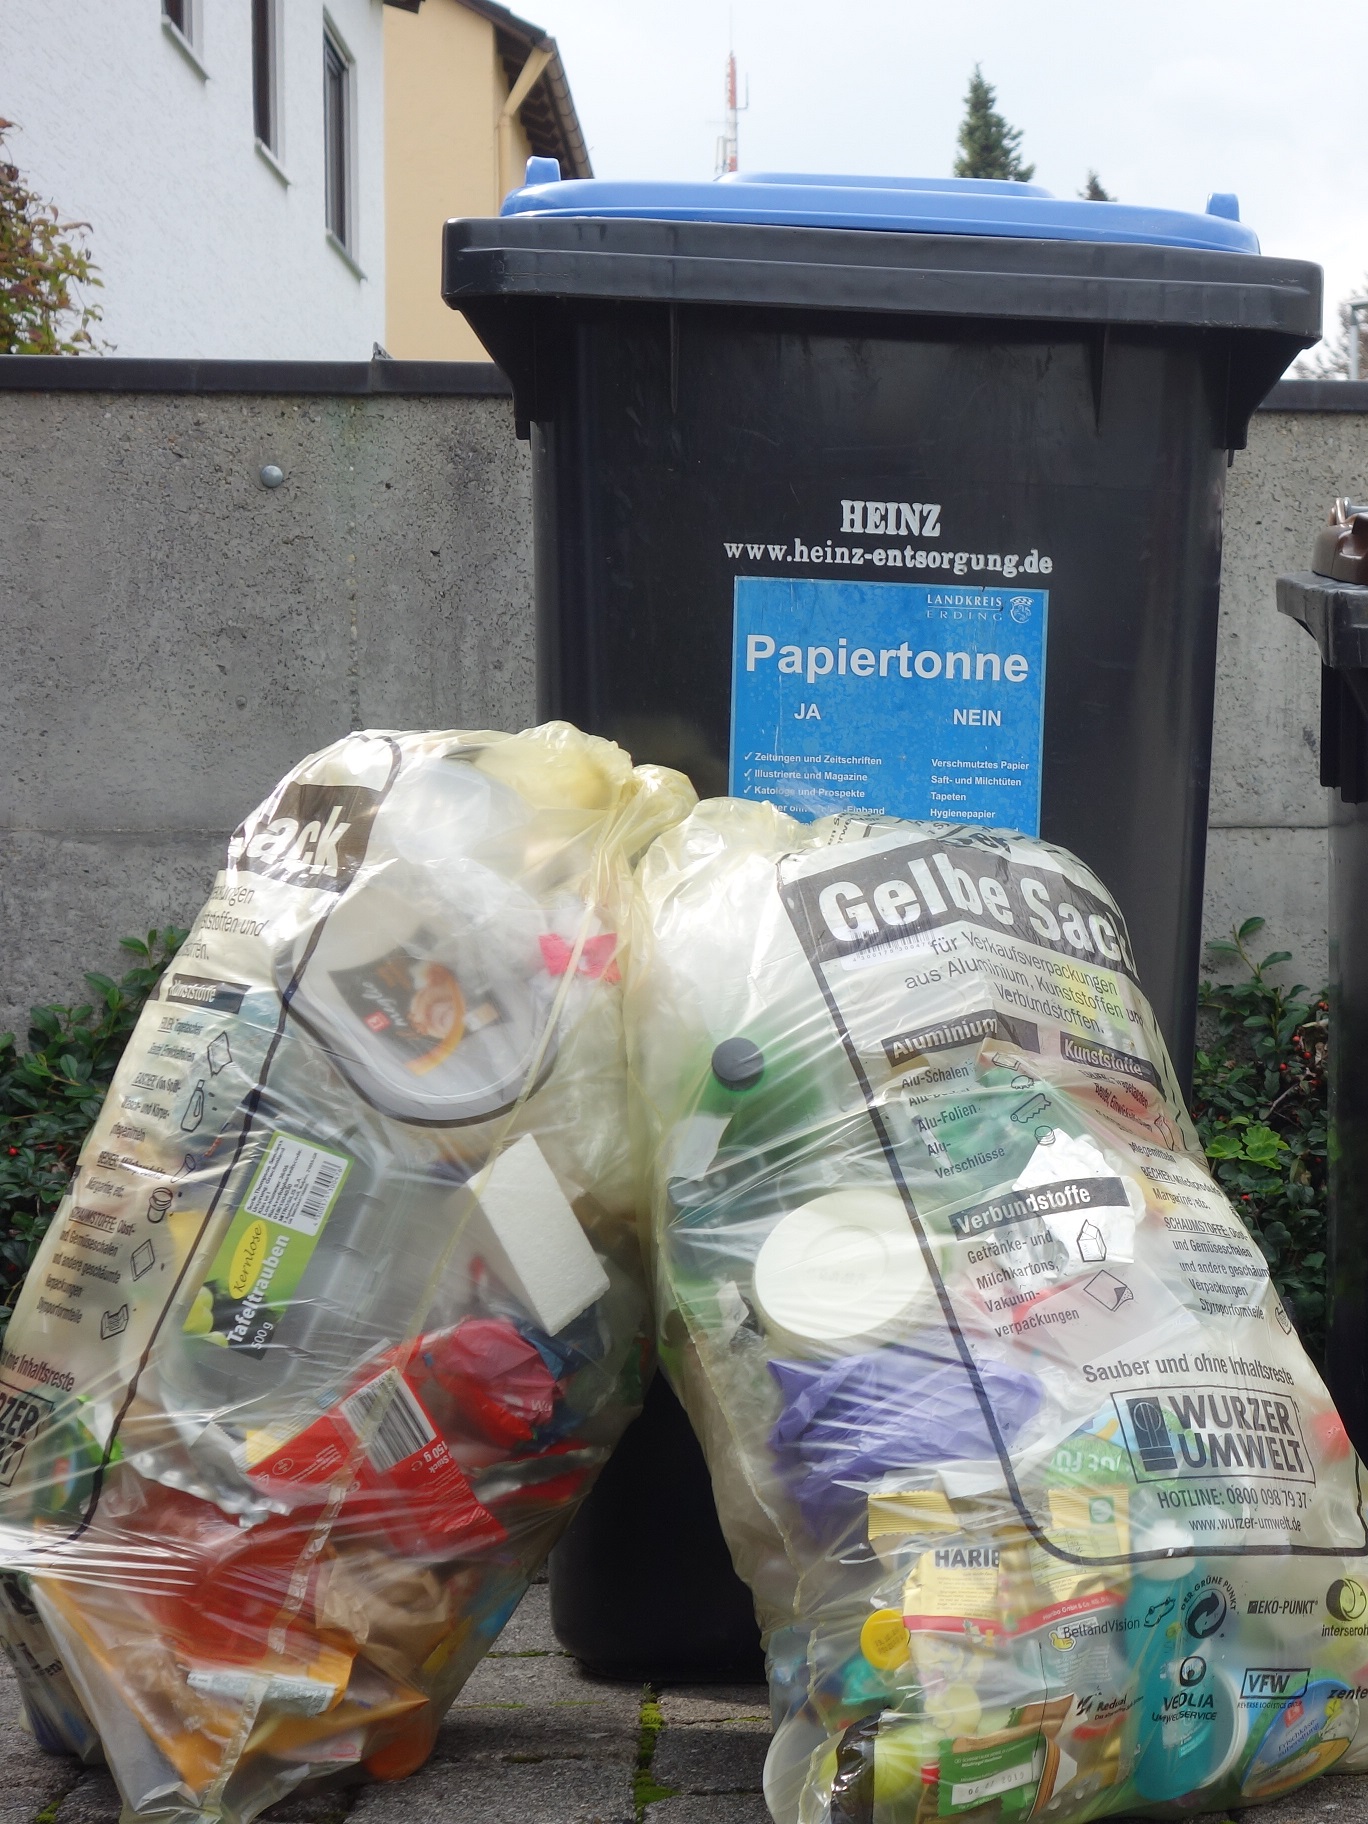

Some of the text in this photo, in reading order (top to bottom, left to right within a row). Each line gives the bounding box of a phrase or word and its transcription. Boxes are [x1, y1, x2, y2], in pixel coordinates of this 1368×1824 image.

[840, 499, 942, 537] HEINZ
[723, 538, 1054, 577] www.heinz-entsorgung.de
[927, 594, 1002, 607] LANDKREIS
[926, 609, 1003, 621] ERDING
[746, 634, 1029, 684] Papiertonne
[794, 703, 821, 720] JA
[953, 708, 1001, 727] NEIN
[754, 752, 882, 765] Zeitungen und Zeitschriften
[931, 759, 1029, 771] Verschmutztes Papier
[754, 769, 868, 783] Illustrierte und Magazine
[930, 775, 1022, 786] Saft- und Milchtüten
[798, 788, 815, 796] und
[818, 788, 865, 799] Prospekte
[930, 792, 966, 802] Tapeten
[930, 809, 996, 819] Hygienepapier
[818, 852, 1014, 941] Gelbe
[931, 937, 957, 955] für
[961, 931, 1118, 996] Verkaufsverpackungen
[169, 979, 217, 1002] Kunststoffe
[905, 969, 941, 989] aus
[948, 957, 1034, 989] Aluminium,
[1034, 975, 1124, 1018] Kunststoffen
[993, 982, 1104, 1034] Verbundstoffen.
[892, 1018, 998, 1059] Aluminium
[1064, 1038, 1143, 1076] Kunststoffe
[901, 1066, 969, 1088] Alu-Schalen
[918, 1103, 977, 1132] Alu-Folien
[927, 1142, 952, 1157] Alu-
[934, 1147, 1006, 1178] Verschlüsse
[956, 1184, 1091, 1234] Verbundstoffe
[1164, 1217, 1230, 1236] SCHAUMSTOFFE:
[967, 1229, 1054, 1264] Getränke- und
[1172, 1239, 1253, 1258] und Gemüseschalen
[233, 1224, 262, 1292] Kernlose
[1179, 1261, 1195, 1273] und
[1198, 1262, 1227, 1274] andere
[976, 1260, 1060, 1290] Milchkartons,
[227, 1235, 290, 1342] Tafeltrauben
[1188, 1278, 1249, 1297] Verpackungen
[984, 1290, 1041, 1313] Vakuum-
[1199, 1298, 1264, 1320] Styroporformteile
[994, 1308, 1080, 1338] verpackungen
[251, 1322, 274, 1350] 500 g
[17, 1354, 75, 1392] Inhaltsreste
[1082, 1353, 1295, 1386] Sauber und ohne Inhaltsreste
[1168, 1394, 1296, 1437] WURZER
[431, 1441, 448, 1459] 150
[1177, 1432, 1305, 1473] UMWELT
[1157, 1488, 1225, 1509] HOTLINE:
[1226, 1487, 1258, 1505] 0800
[1260, 1488, 1281, 1505] 098
[1281, 1490, 1296, 1507] 79
[1188, 1516, 1302, 1532] www.wurzer-umwelt.de
[1181, 1575, 1237, 1611] DER GRÜNE PUNKT
[1063, 1617, 1140, 1639] BellandVision
[1321, 1624, 1368, 1637] interseroh
[1248, 1674, 1290, 1694] VFW
[1163, 1692, 1214, 1712] VEOLIA
